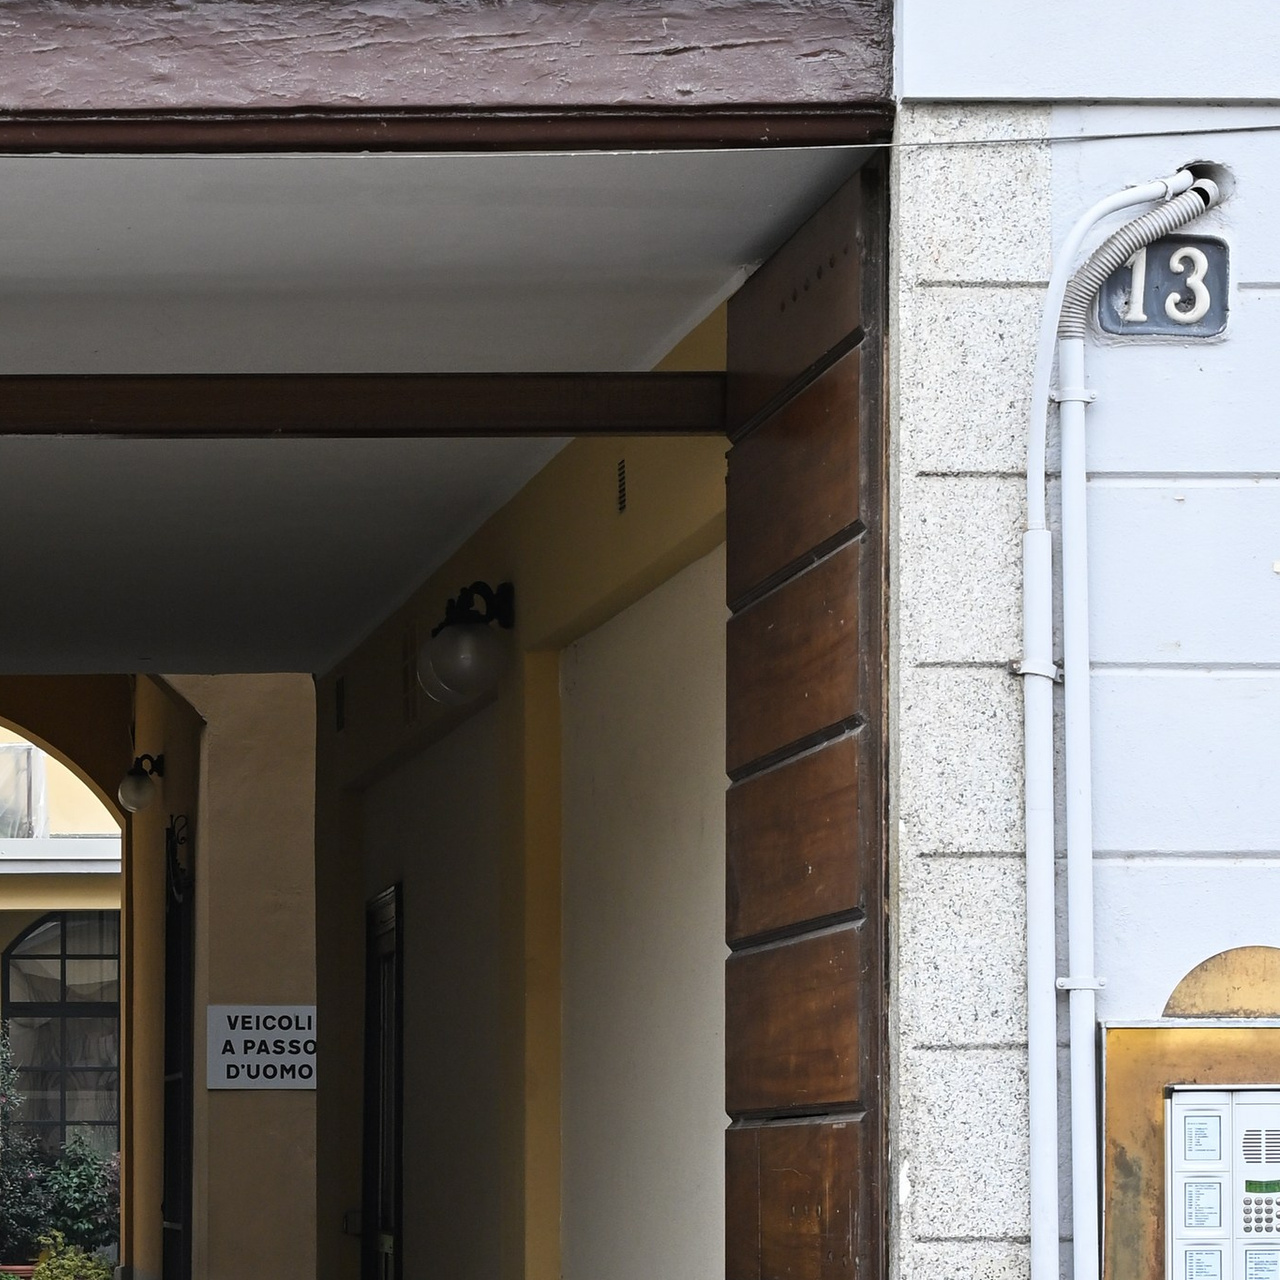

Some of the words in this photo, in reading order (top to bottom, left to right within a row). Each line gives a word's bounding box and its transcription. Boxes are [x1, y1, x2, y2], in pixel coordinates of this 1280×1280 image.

[1123, 246, 1212, 325] 13
[226, 1014, 312, 1031] VEICOLI
[221, 1039, 236, 1055] A
[243, 1039, 317, 1055] PASSO
[226, 1064, 314, 1080] D'UOMO
